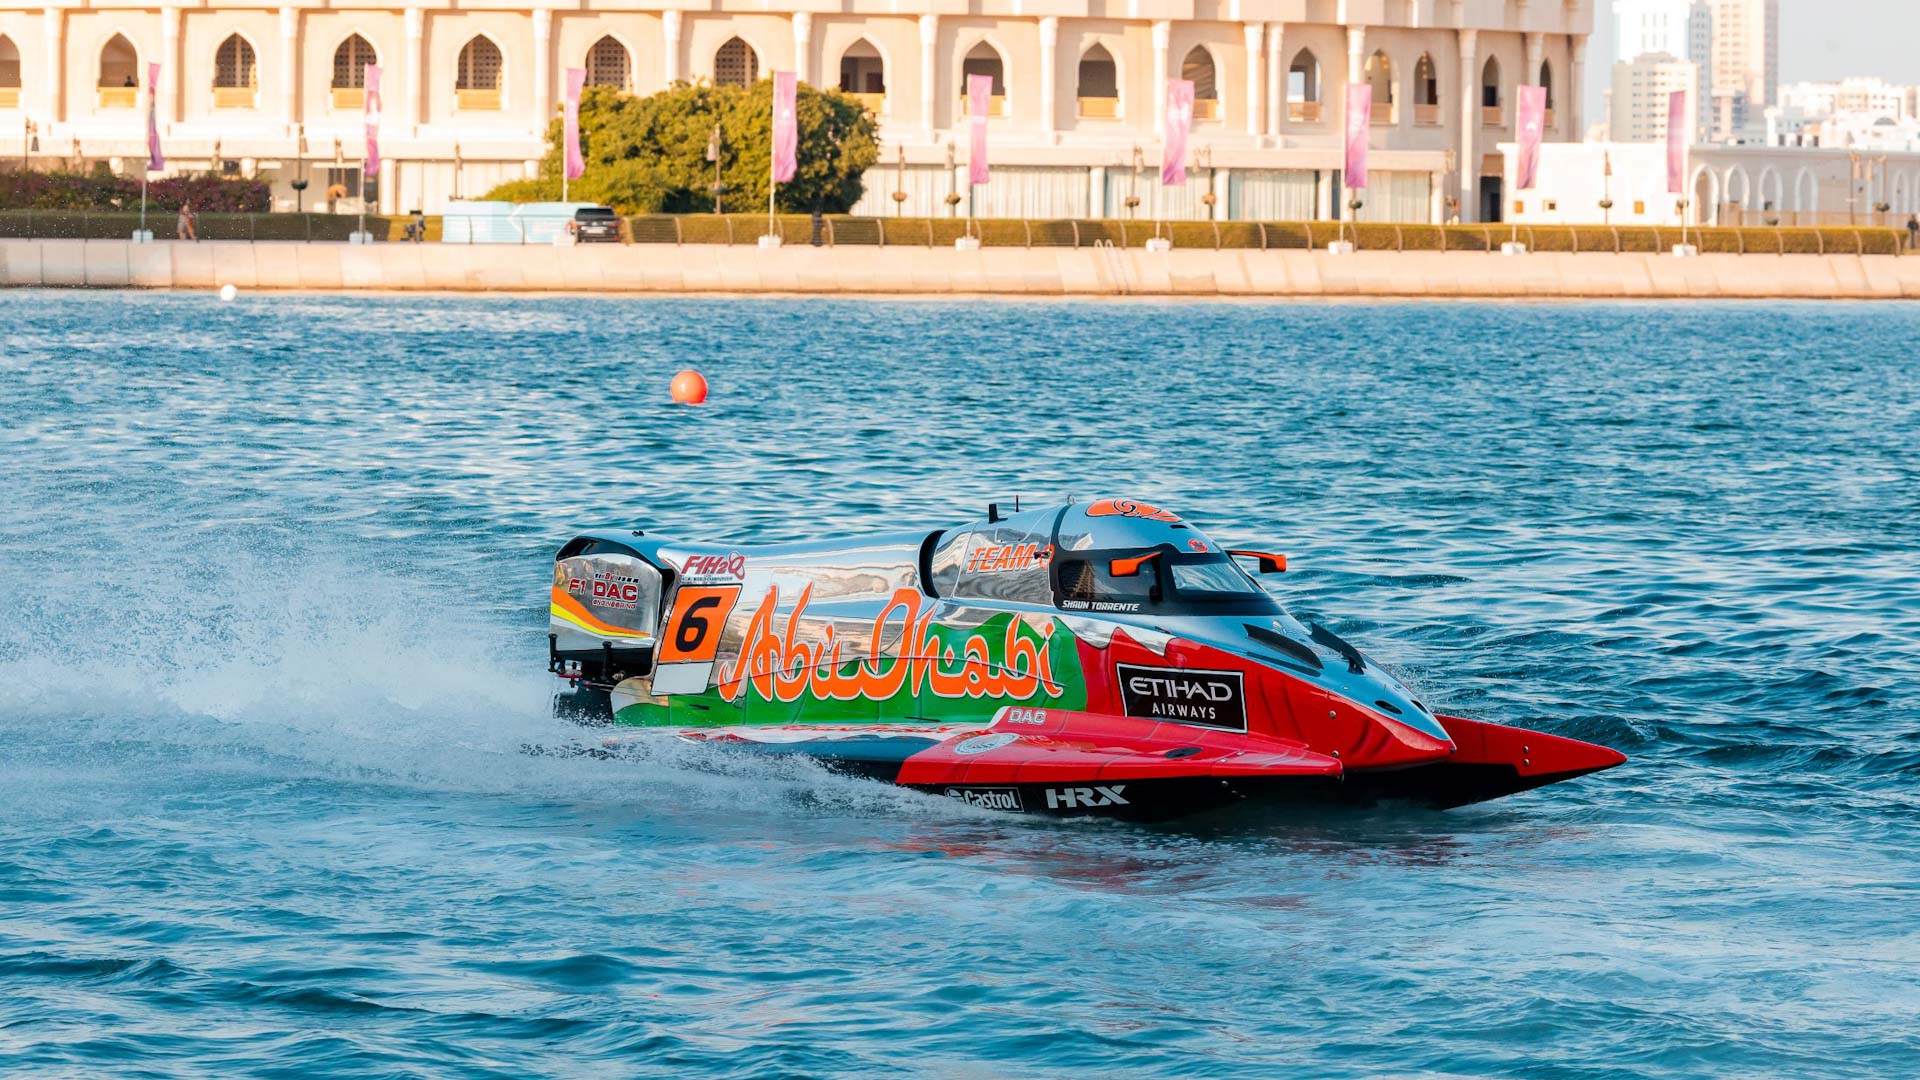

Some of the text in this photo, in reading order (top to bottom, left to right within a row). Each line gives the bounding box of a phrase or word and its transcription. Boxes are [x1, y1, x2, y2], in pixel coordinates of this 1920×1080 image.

[967, 542, 1039, 573] TEAM
[568, 578, 638, 602] F1 DAC
[1062, 600, 1141, 611] SHAUN TORRENTE
[675, 596, 722, 652] 6
[718, 581, 1063, 702] Abu Dhabi
[1129, 676, 1233, 701] ETIHAD
[1008, 708, 1047, 725] DAC
[1152, 702, 1216, 720] AIRWAYS
[964, 784, 1131, 810] Castrol HRX
